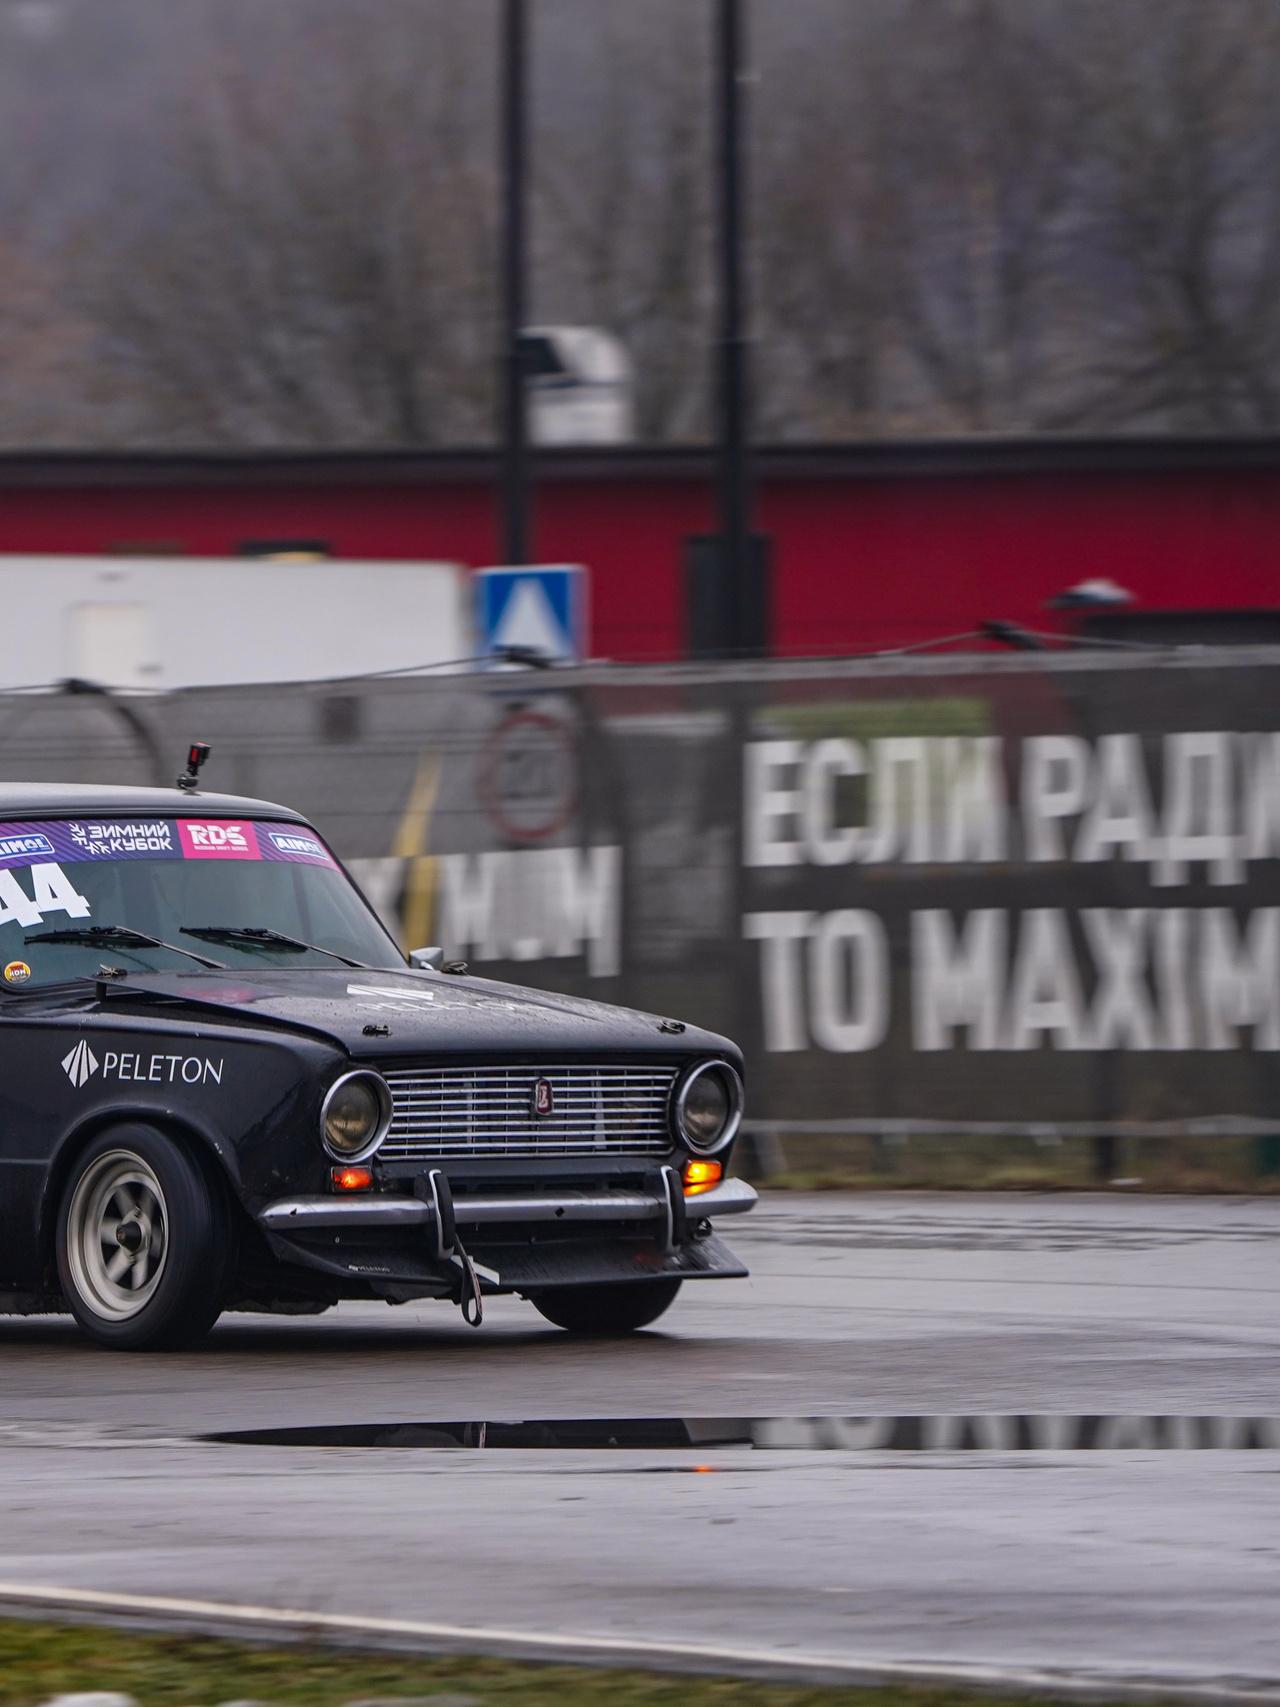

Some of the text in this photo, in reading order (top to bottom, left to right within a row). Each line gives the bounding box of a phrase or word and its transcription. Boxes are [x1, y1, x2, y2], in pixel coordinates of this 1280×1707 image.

[743, 736, 1008, 866] ЕСЛИ
[88, 821, 170, 838] ЗИМНИЙ
[186, 825, 248, 845] RDS
[110, 838, 173, 851] КУБОК
[743, 908, 889, 1052] ТО
[103, 1052, 223, 1084] PELETON
